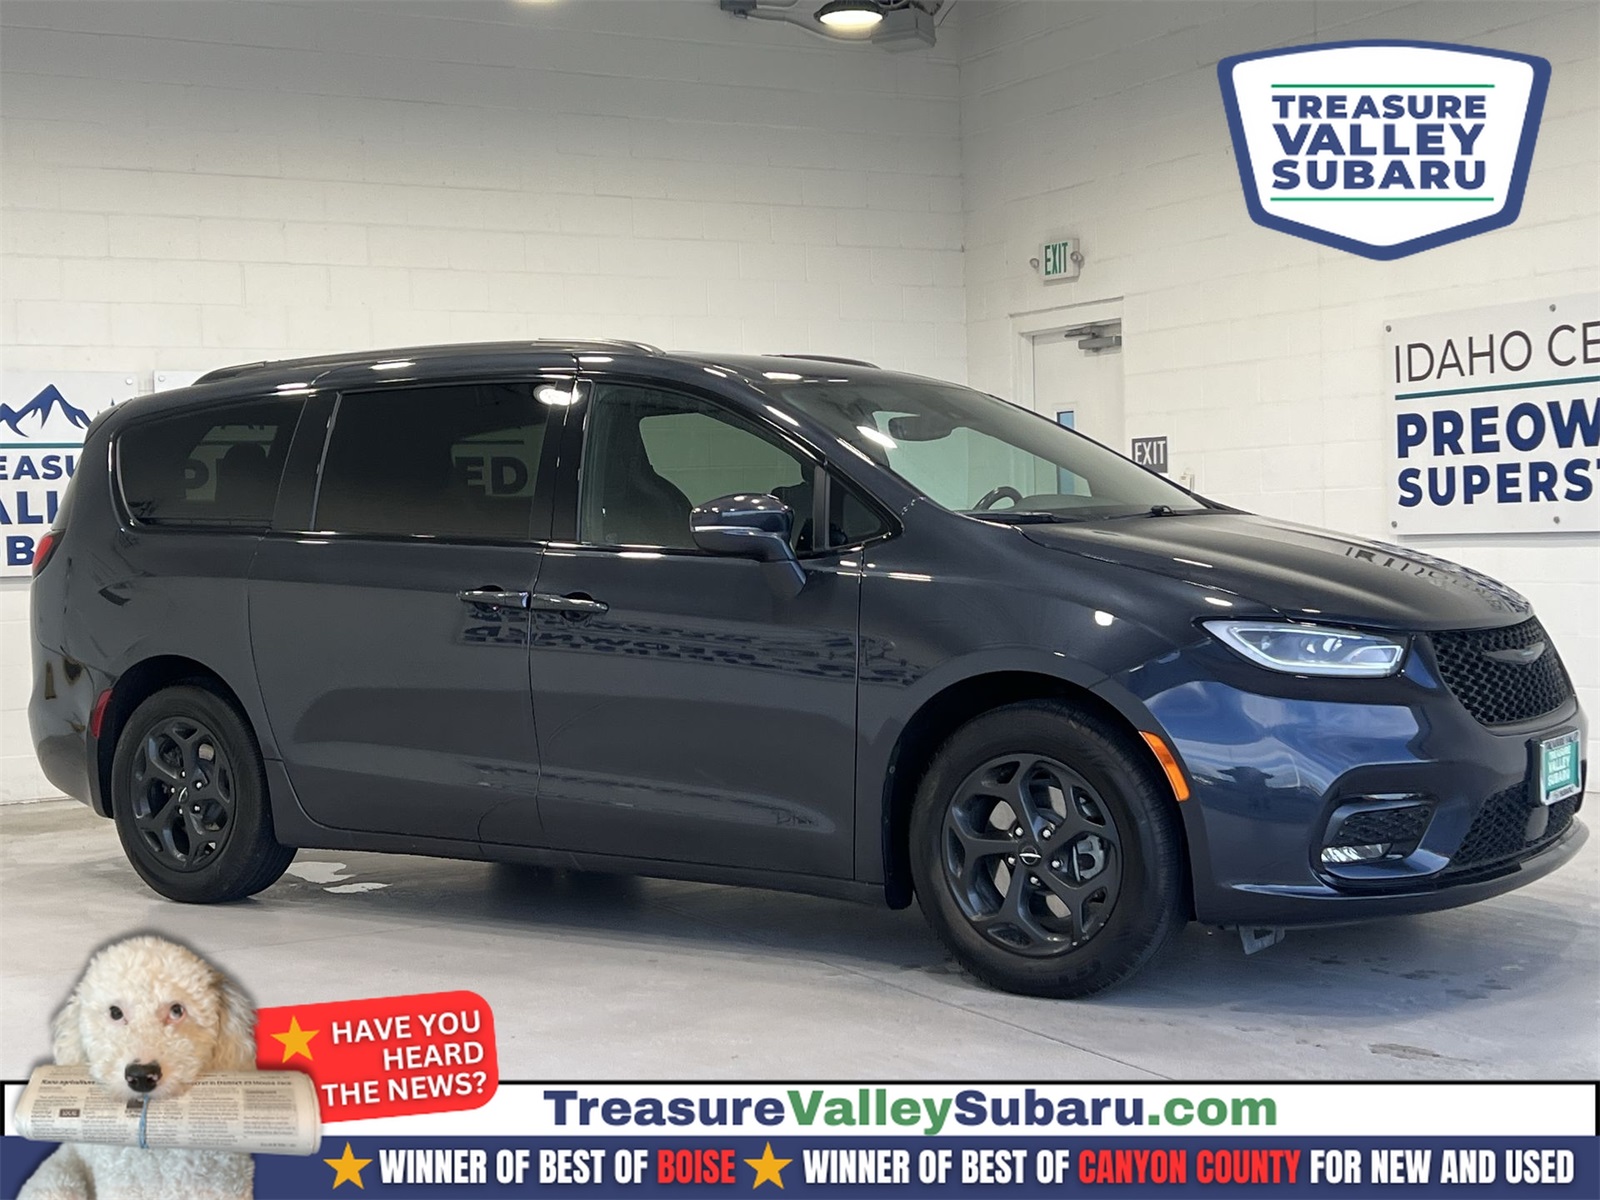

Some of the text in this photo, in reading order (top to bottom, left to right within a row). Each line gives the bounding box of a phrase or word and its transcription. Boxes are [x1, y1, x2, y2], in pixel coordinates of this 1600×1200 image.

[1044, 242, 1068, 276] EXIT
[1395, 330, 1532, 384] IDAHO
[1397, 397, 1600, 459] PREOW
[1134, 440, 1166, 466] EXIT
[1398, 458, 1600, 507] SUPERS
